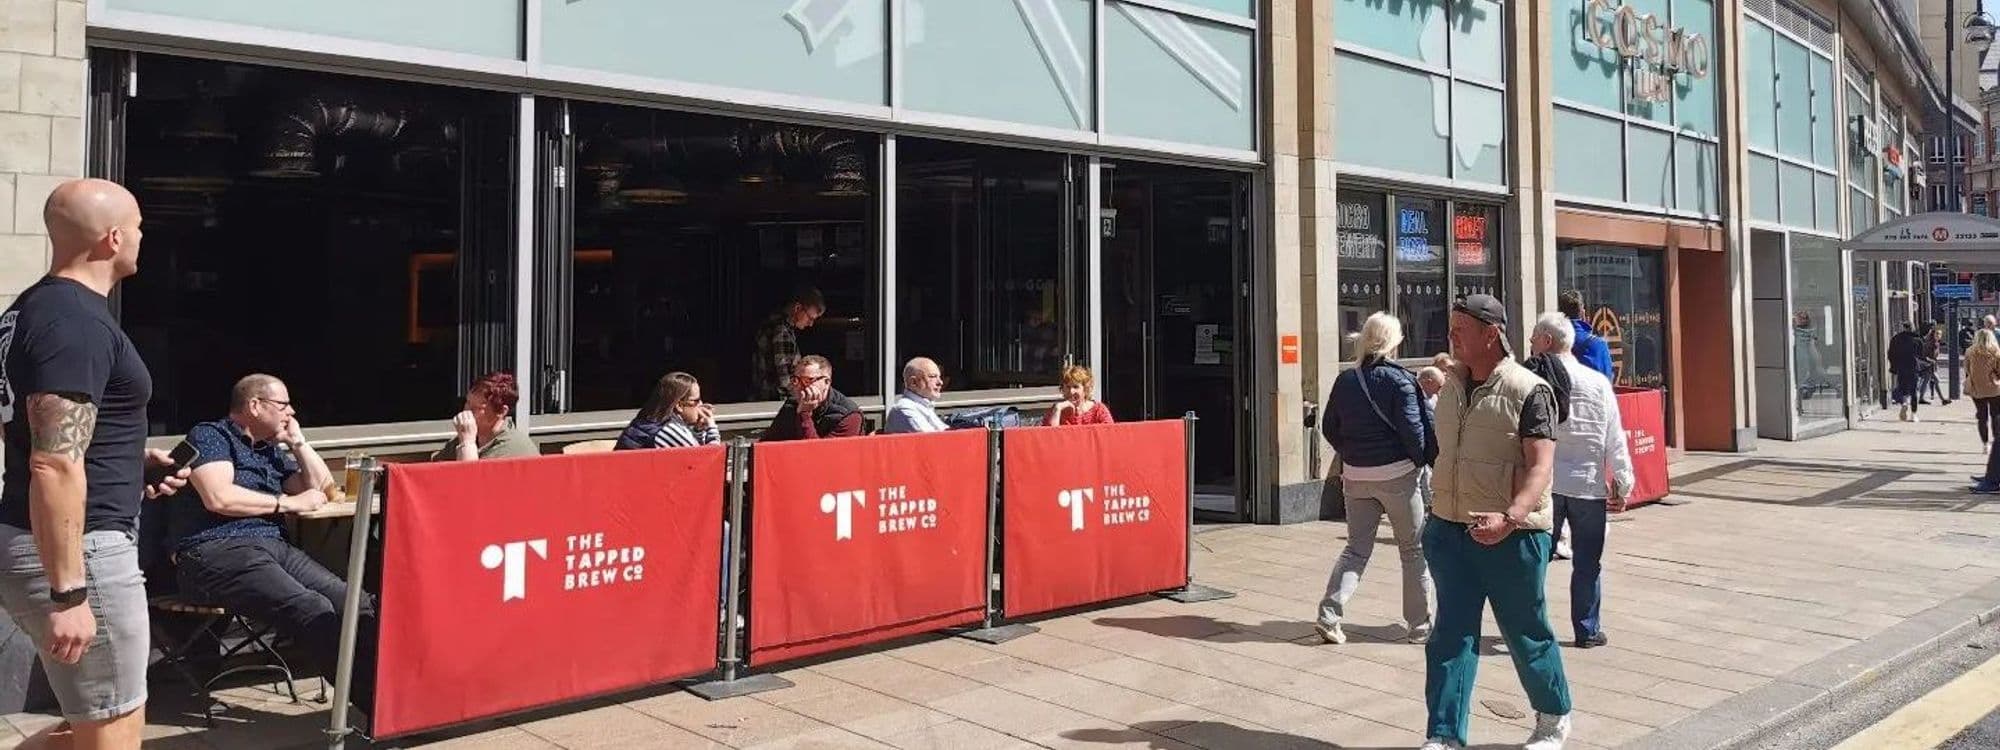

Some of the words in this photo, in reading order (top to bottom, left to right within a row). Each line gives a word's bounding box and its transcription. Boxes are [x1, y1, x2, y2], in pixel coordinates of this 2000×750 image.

[1585, 0, 1708, 78] COSMO
[878, 485, 907, 502] THE
[1103, 483, 1126, 498] THE
[878, 498, 937, 518] TAPPED
[1103, 495, 1150, 511] TAPPED
[878, 515, 917, 534] BREW
[1103, 511, 1135, 526] BREW
[566, 532, 605, 551] THE
[565, 546, 645, 571] TAPPED
[564, 567, 618, 590] BREW
